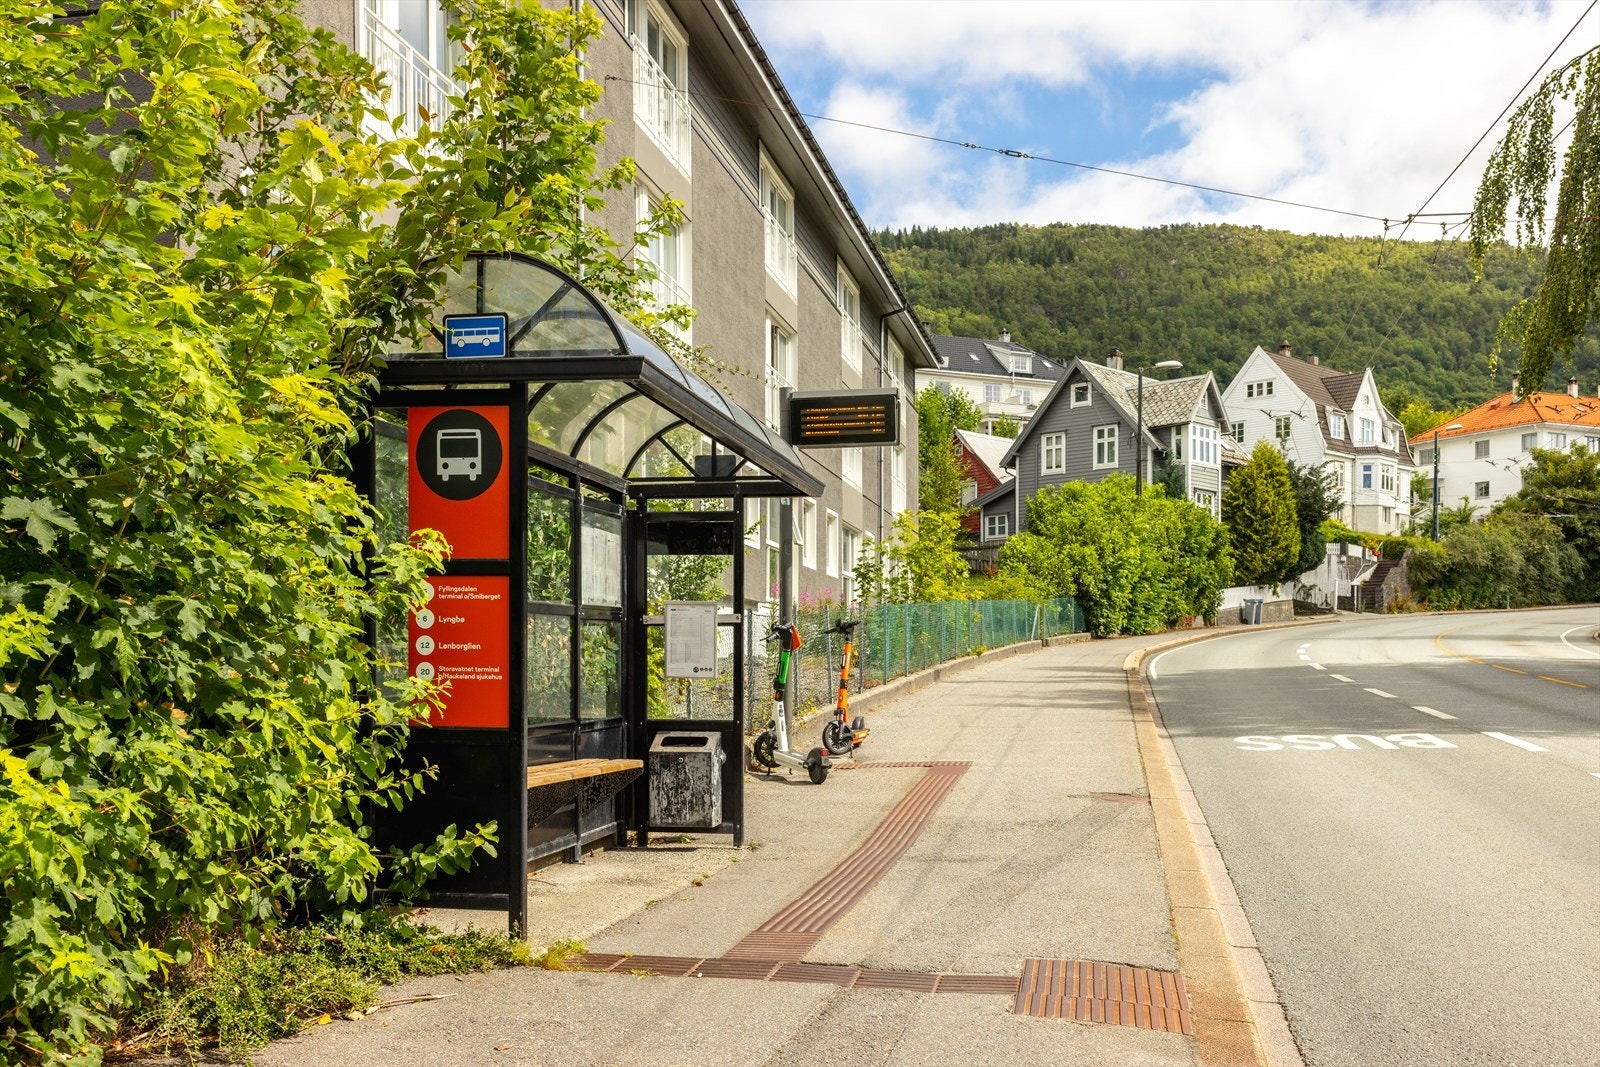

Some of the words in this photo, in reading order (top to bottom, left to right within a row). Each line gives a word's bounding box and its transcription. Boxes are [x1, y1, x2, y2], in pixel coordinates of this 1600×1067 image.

[438, 615, 465, 624] Lyngbø
[438, 642, 481, 651] Lønborglien
[476, 673, 503, 681] sjukehus
[1233, 733, 1459, 751] BUSS
